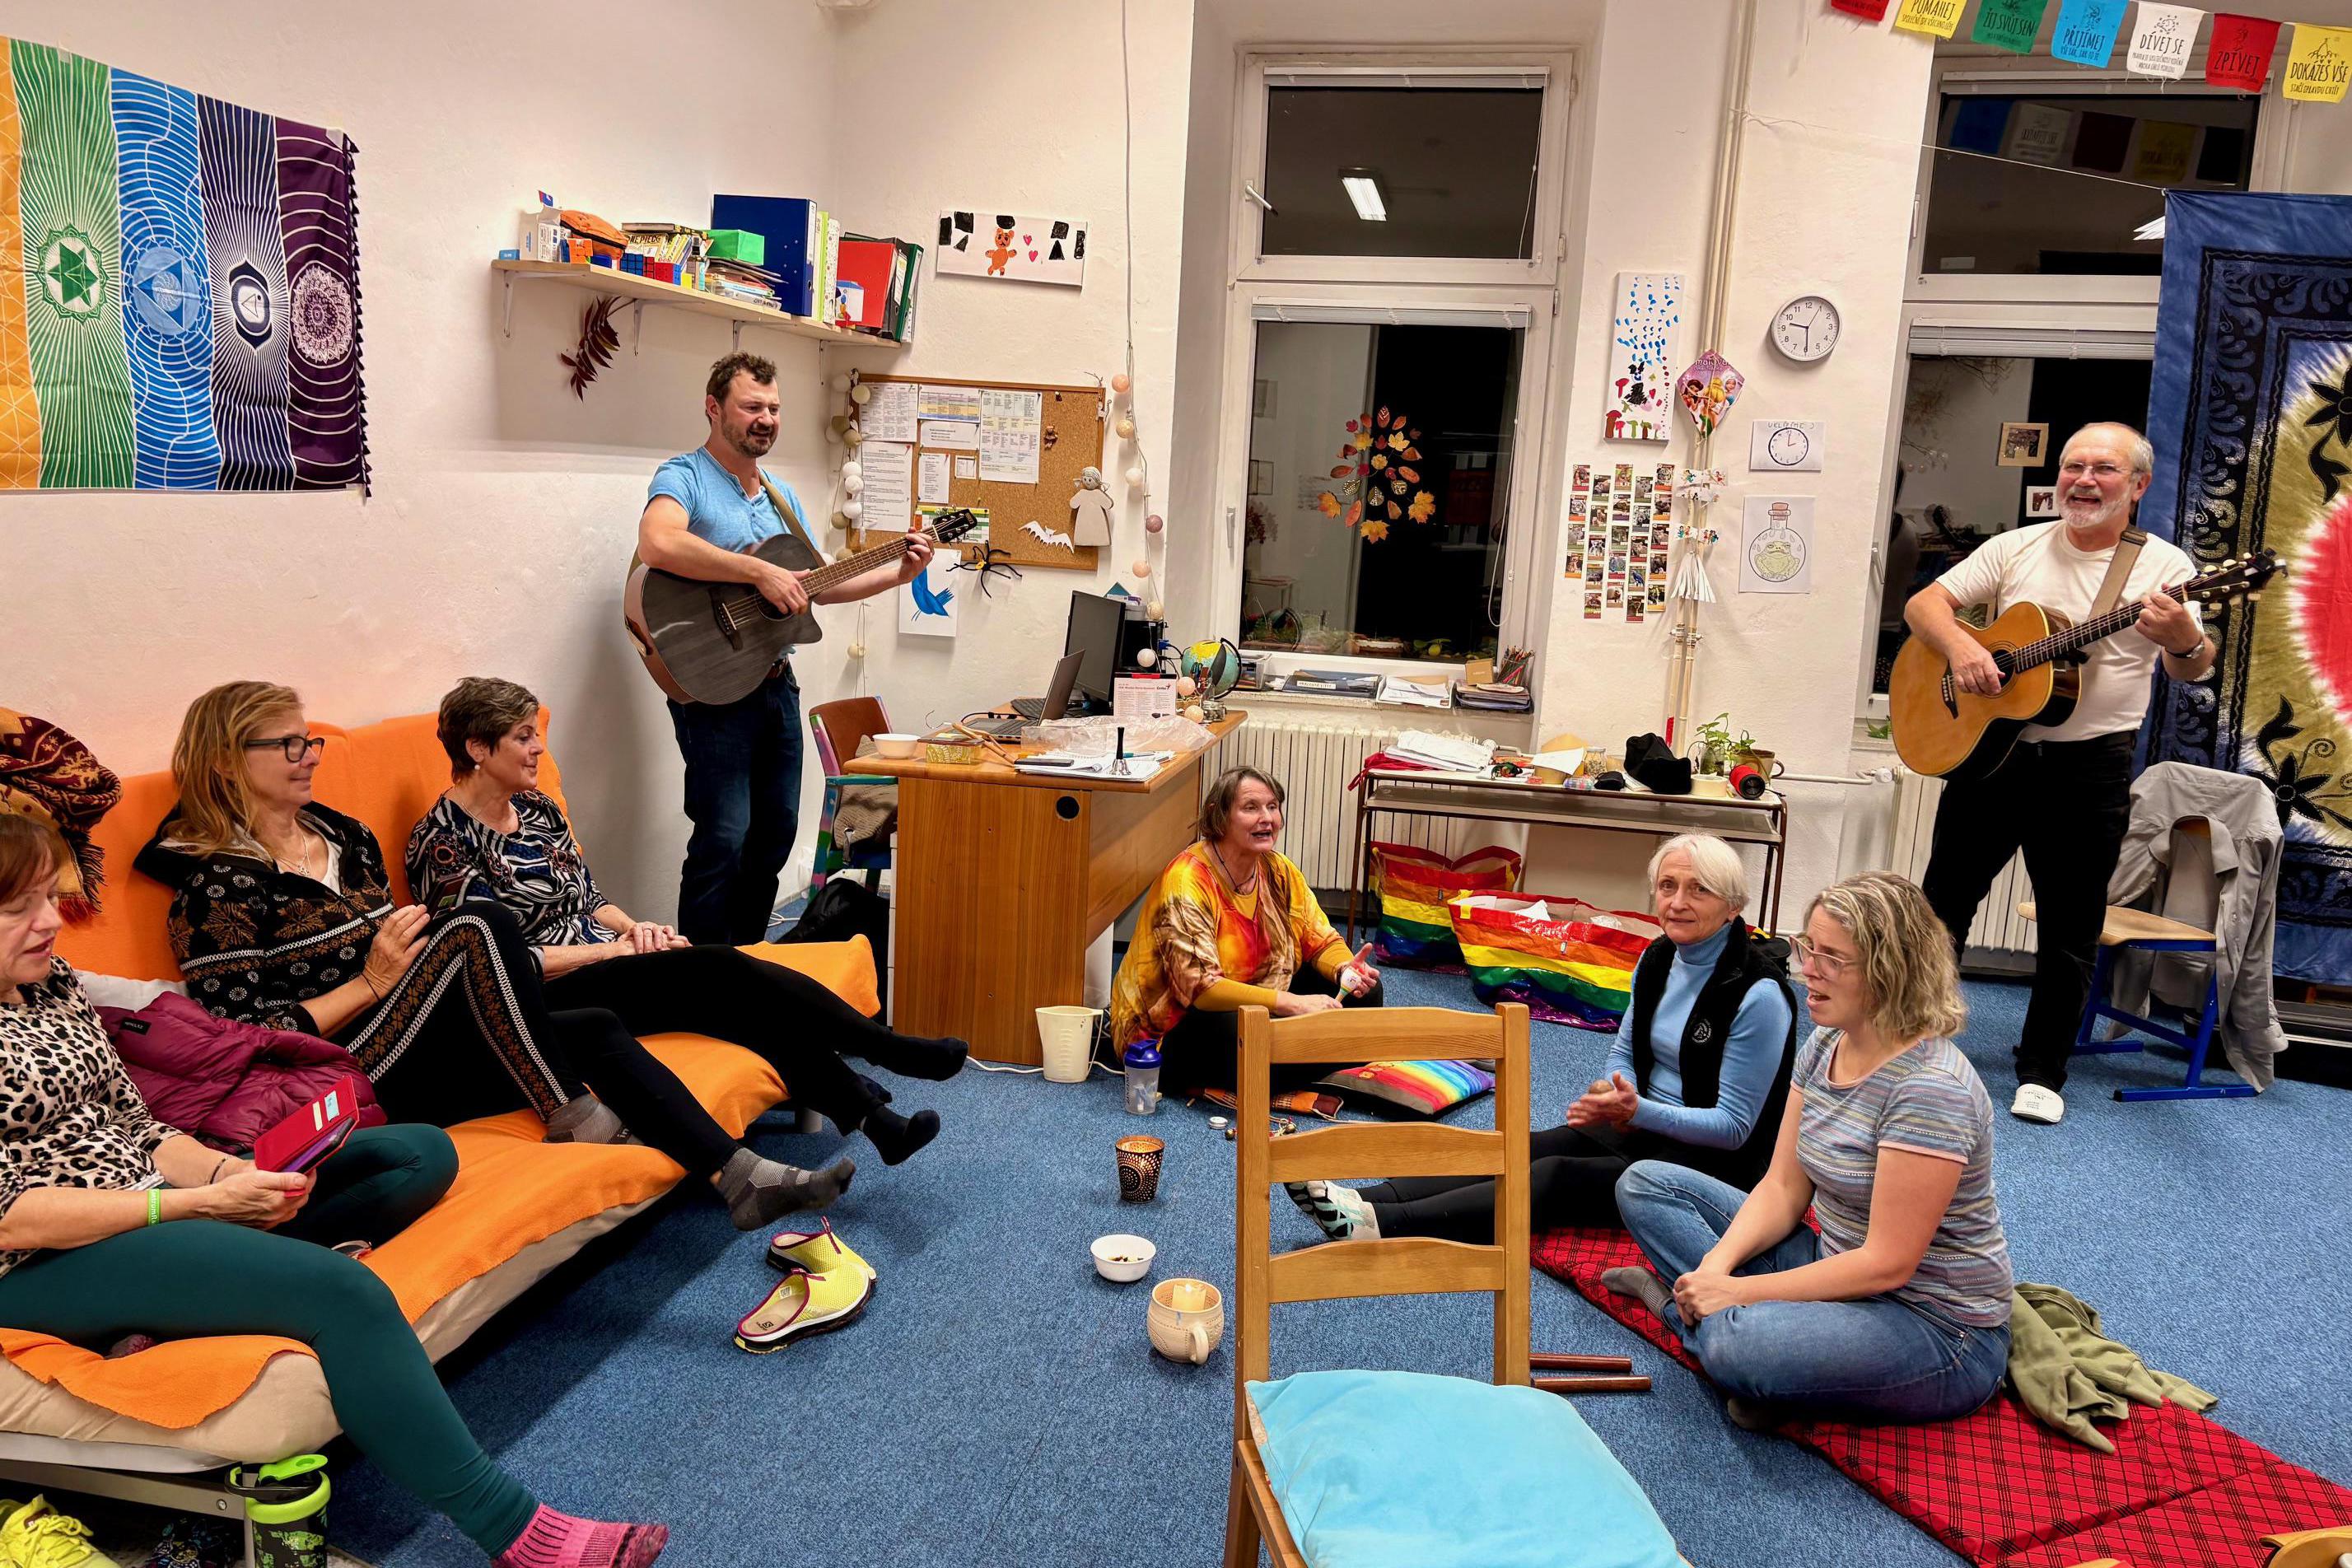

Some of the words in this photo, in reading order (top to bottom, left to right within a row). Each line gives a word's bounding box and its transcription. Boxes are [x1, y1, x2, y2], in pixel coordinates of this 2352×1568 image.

[2016, 19, 2036, 36] SEN
[2063, 26, 2105, 52] PŘIJÍMEJ
[2140, 31, 2172, 54] DÍVEJ
[2172, 38, 2185, 54] SE
[2214, 47, 2260, 77] ZPÍVEJ
[2290, 59, 2331, 82] DOKÁŽEŠ
[2332, 61, 2349, 82] VŠE
